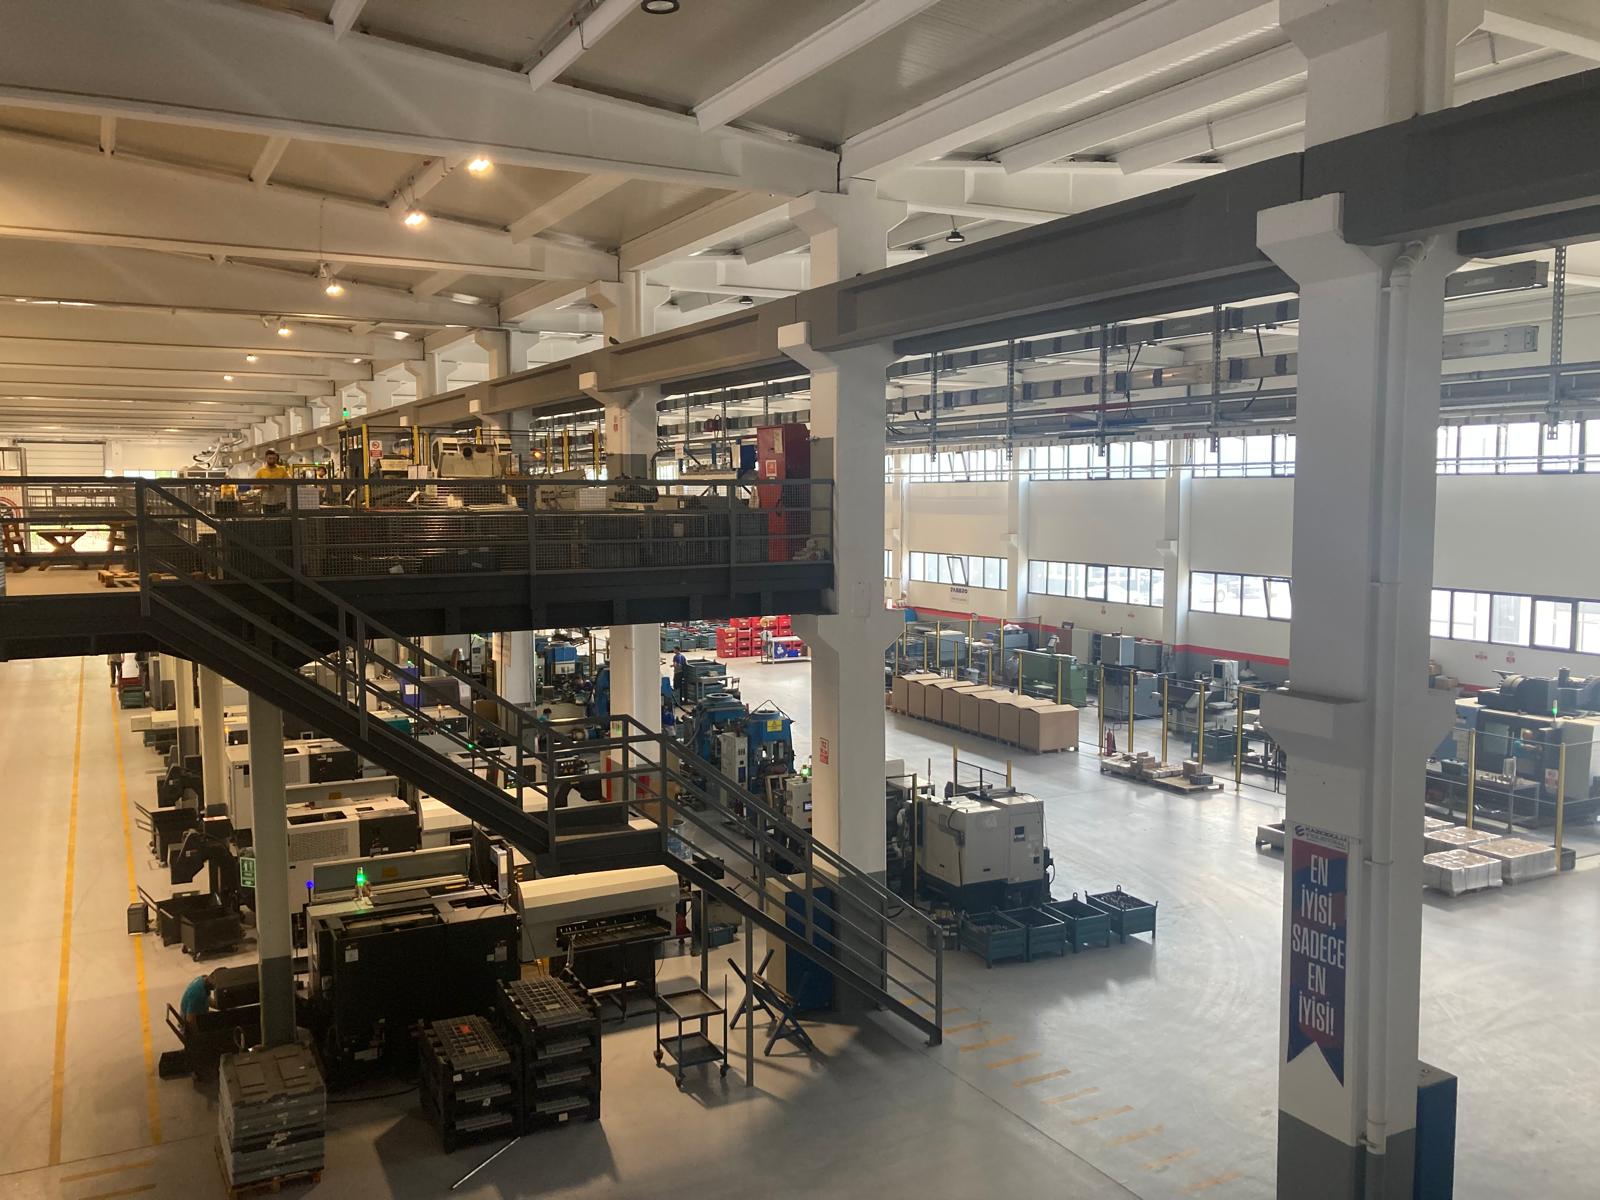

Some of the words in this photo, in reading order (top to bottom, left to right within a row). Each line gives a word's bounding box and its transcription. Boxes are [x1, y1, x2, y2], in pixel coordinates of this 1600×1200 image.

[1311, 854, 1328, 887] EN
[1301, 884, 1336, 931] İYİSİ,
[1292, 923, 1345, 969] SADECE
[1308, 962, 1326, 996] EN
[1299, 990, 1334, 1037] İYİSİ!
